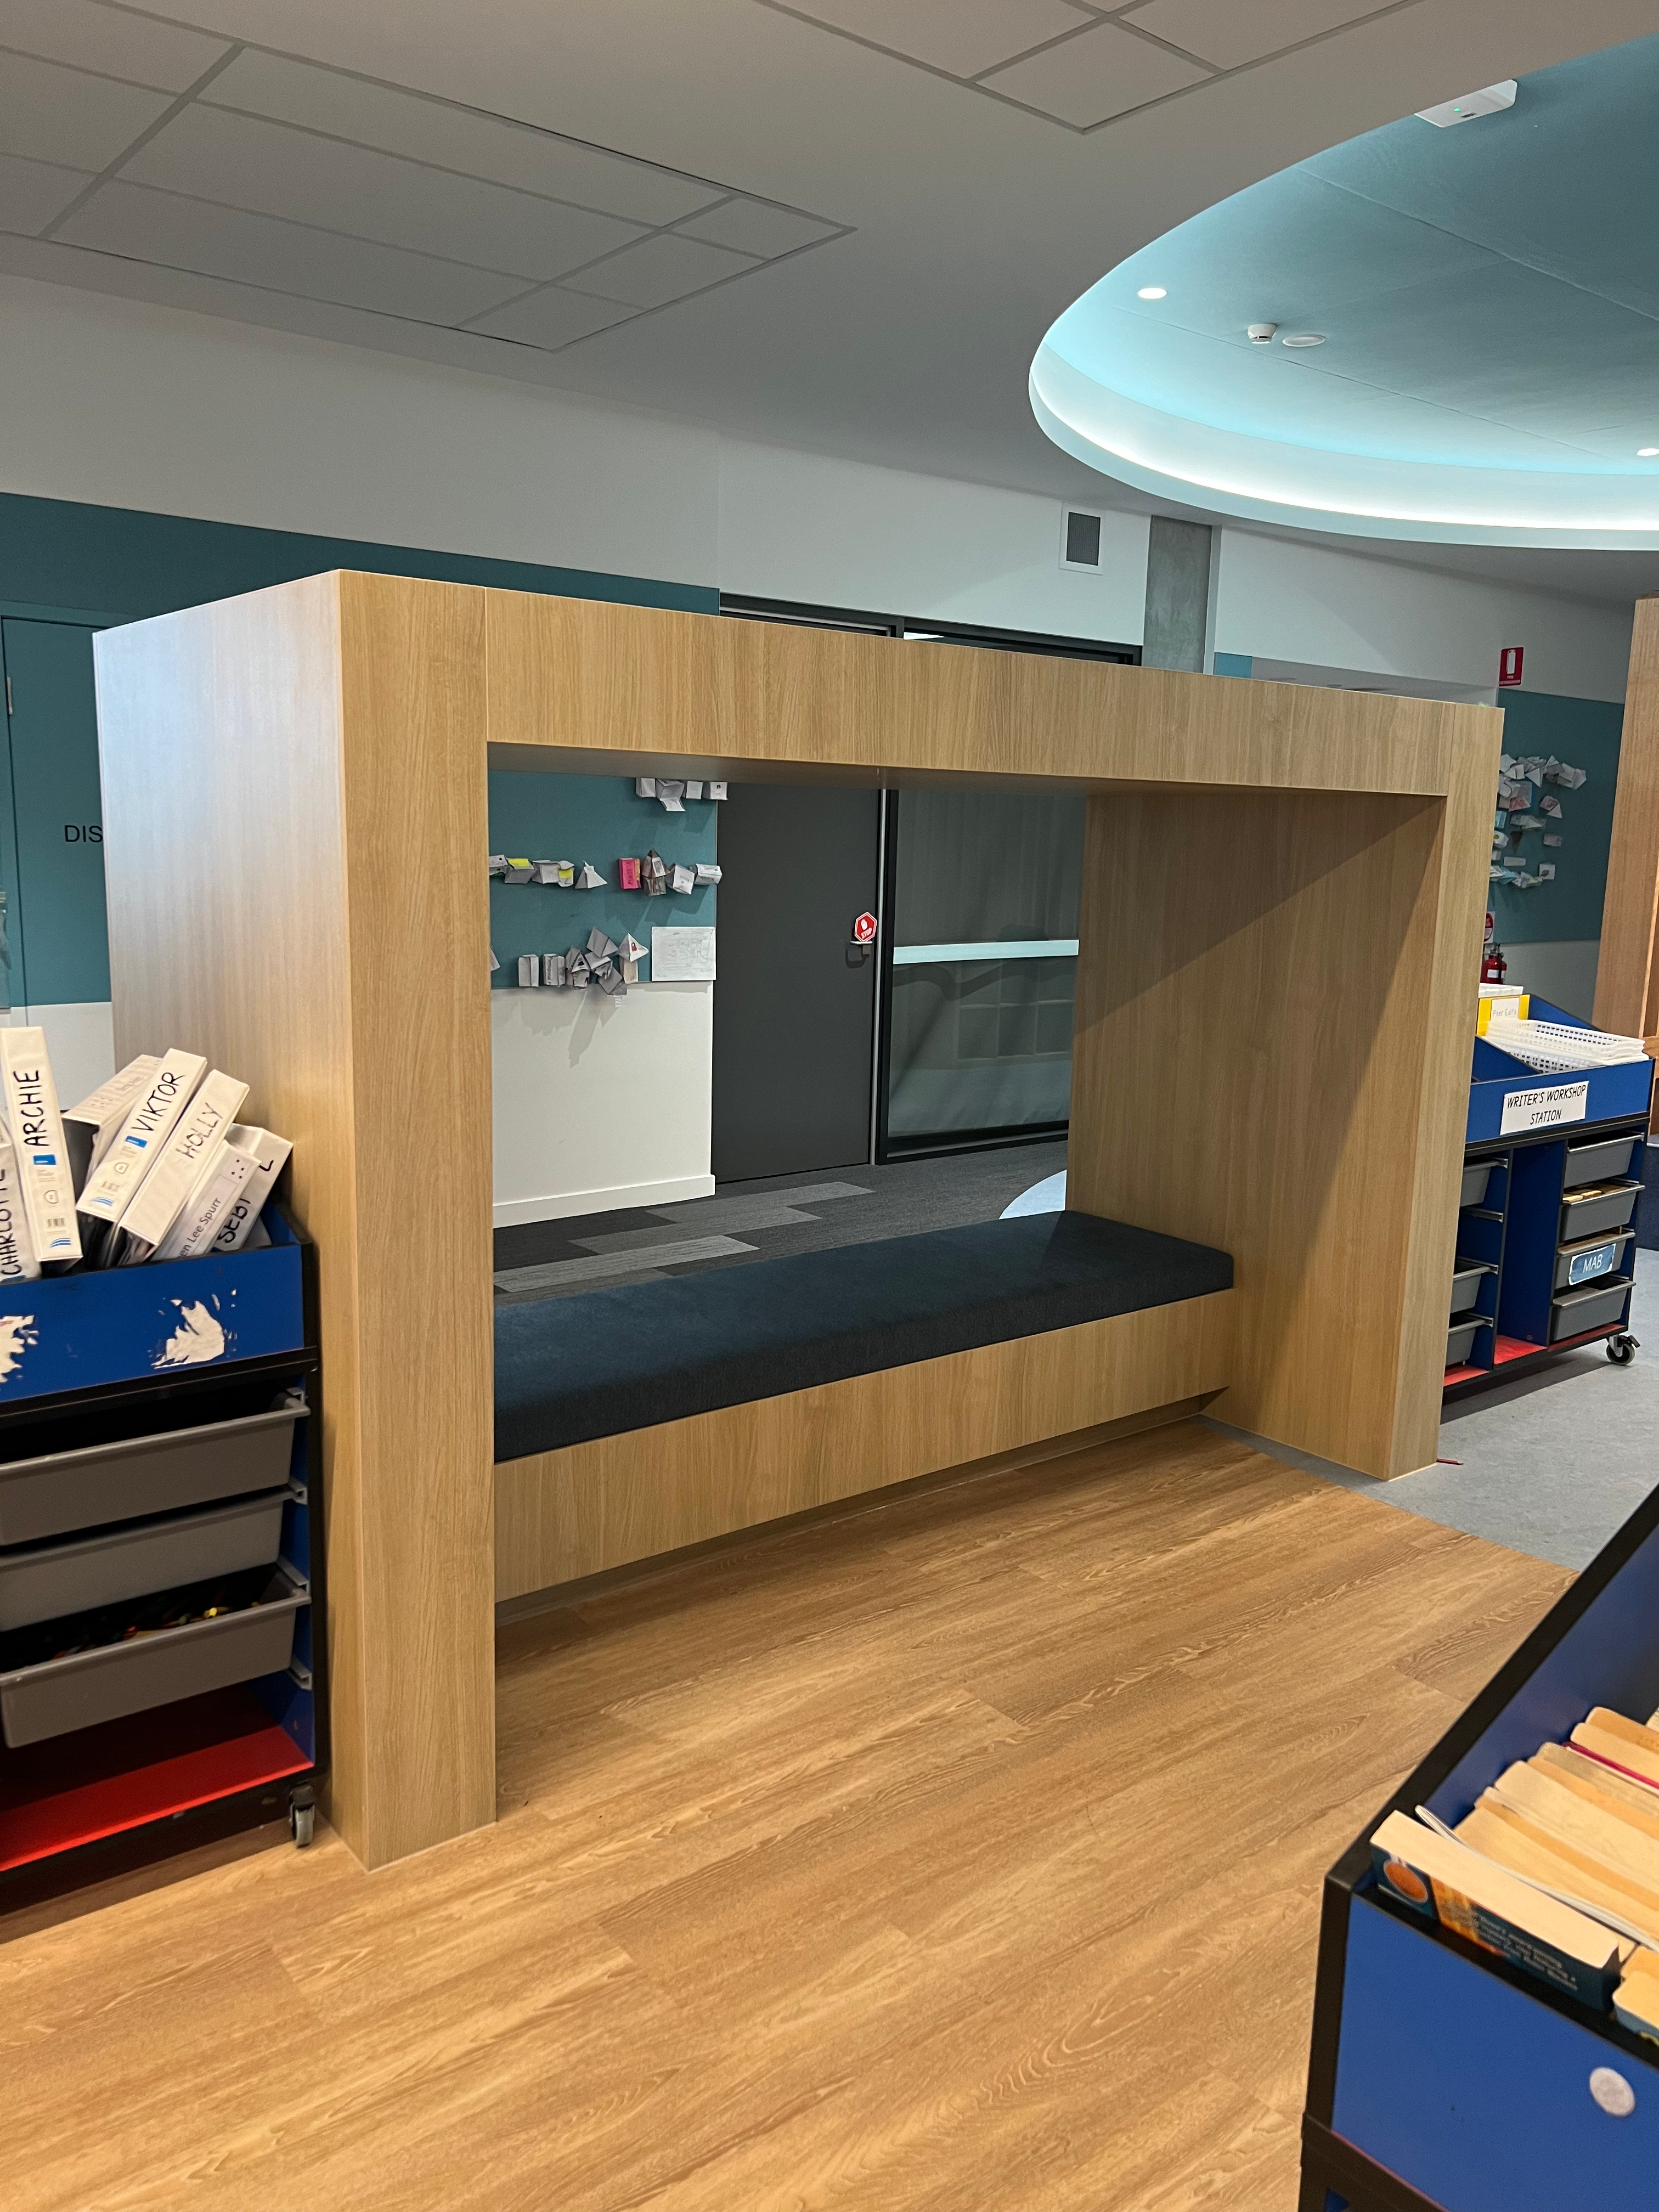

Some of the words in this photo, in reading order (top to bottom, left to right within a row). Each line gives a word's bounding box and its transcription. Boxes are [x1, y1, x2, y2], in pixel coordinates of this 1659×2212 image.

[13, 1069, 50, 1147] ARCHIE
[131, 1072, 186, 1131] VIKTOR
[1506, 1092, 1545, 1109] WRITER'S
[1546, 1085, 1586, 1102] WORKSHOP
[1530, 1109, 1562, 1125] STATION
[176, 1102, 223, 1159] HOLLY
[187, 1226, 204, 1243] Lee
[200, 1197, 222, 1226] Spurr
[1583, 1254, 1603, 1273] MAB
